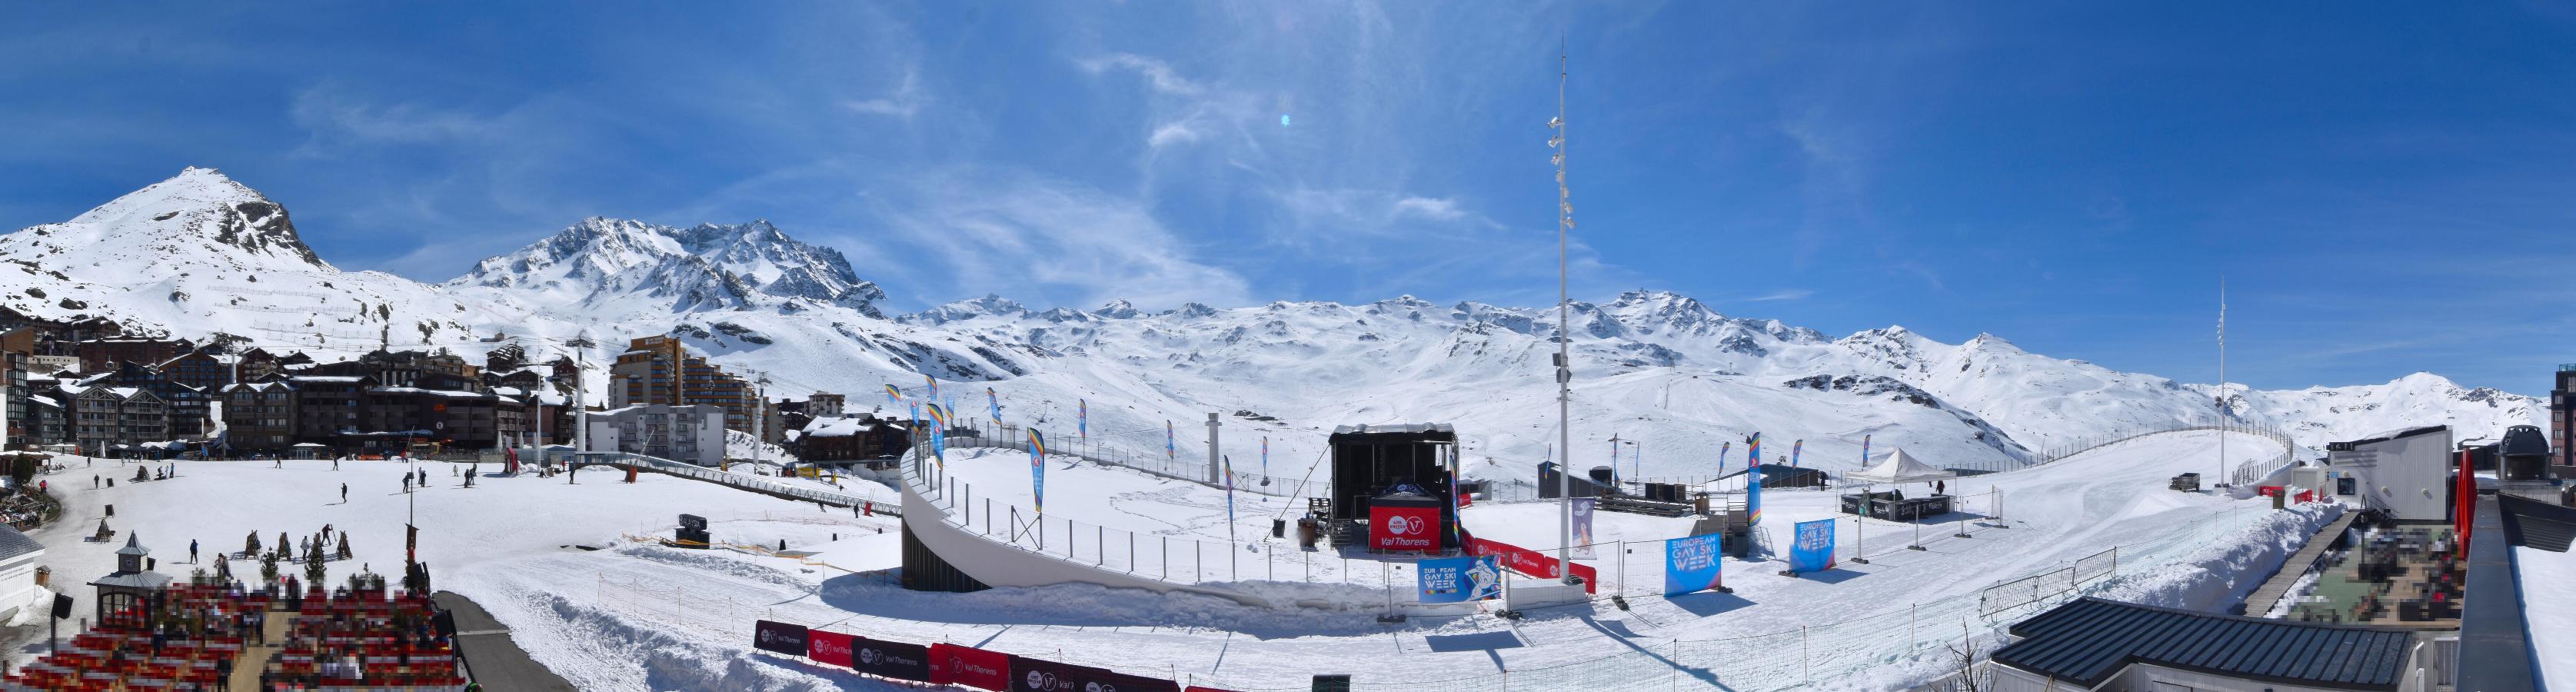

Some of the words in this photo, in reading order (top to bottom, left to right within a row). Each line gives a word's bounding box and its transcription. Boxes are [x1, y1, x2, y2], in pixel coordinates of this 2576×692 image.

[1799, 521, 1832, 531] EUROPEAN
[1800, 530, 1817, 540] GAY
[1820, 527, 1831, 537] SKI
[1396, 537, 1429, 546] Thorens
[1672, 535, 1716, 549] EUROPEAN
[1798, 536, 1831, 551] WEEK
[1672, 546, 1696, 559] GAY
[1700, 544, 1716, 554] SKI
[1672, 554, 1716, 571] WEEK
[1424, 580, 1456, 589] WEEK
[895, 657, 917, 666] Thorens
[973, 665, 997, 676] Thorens
